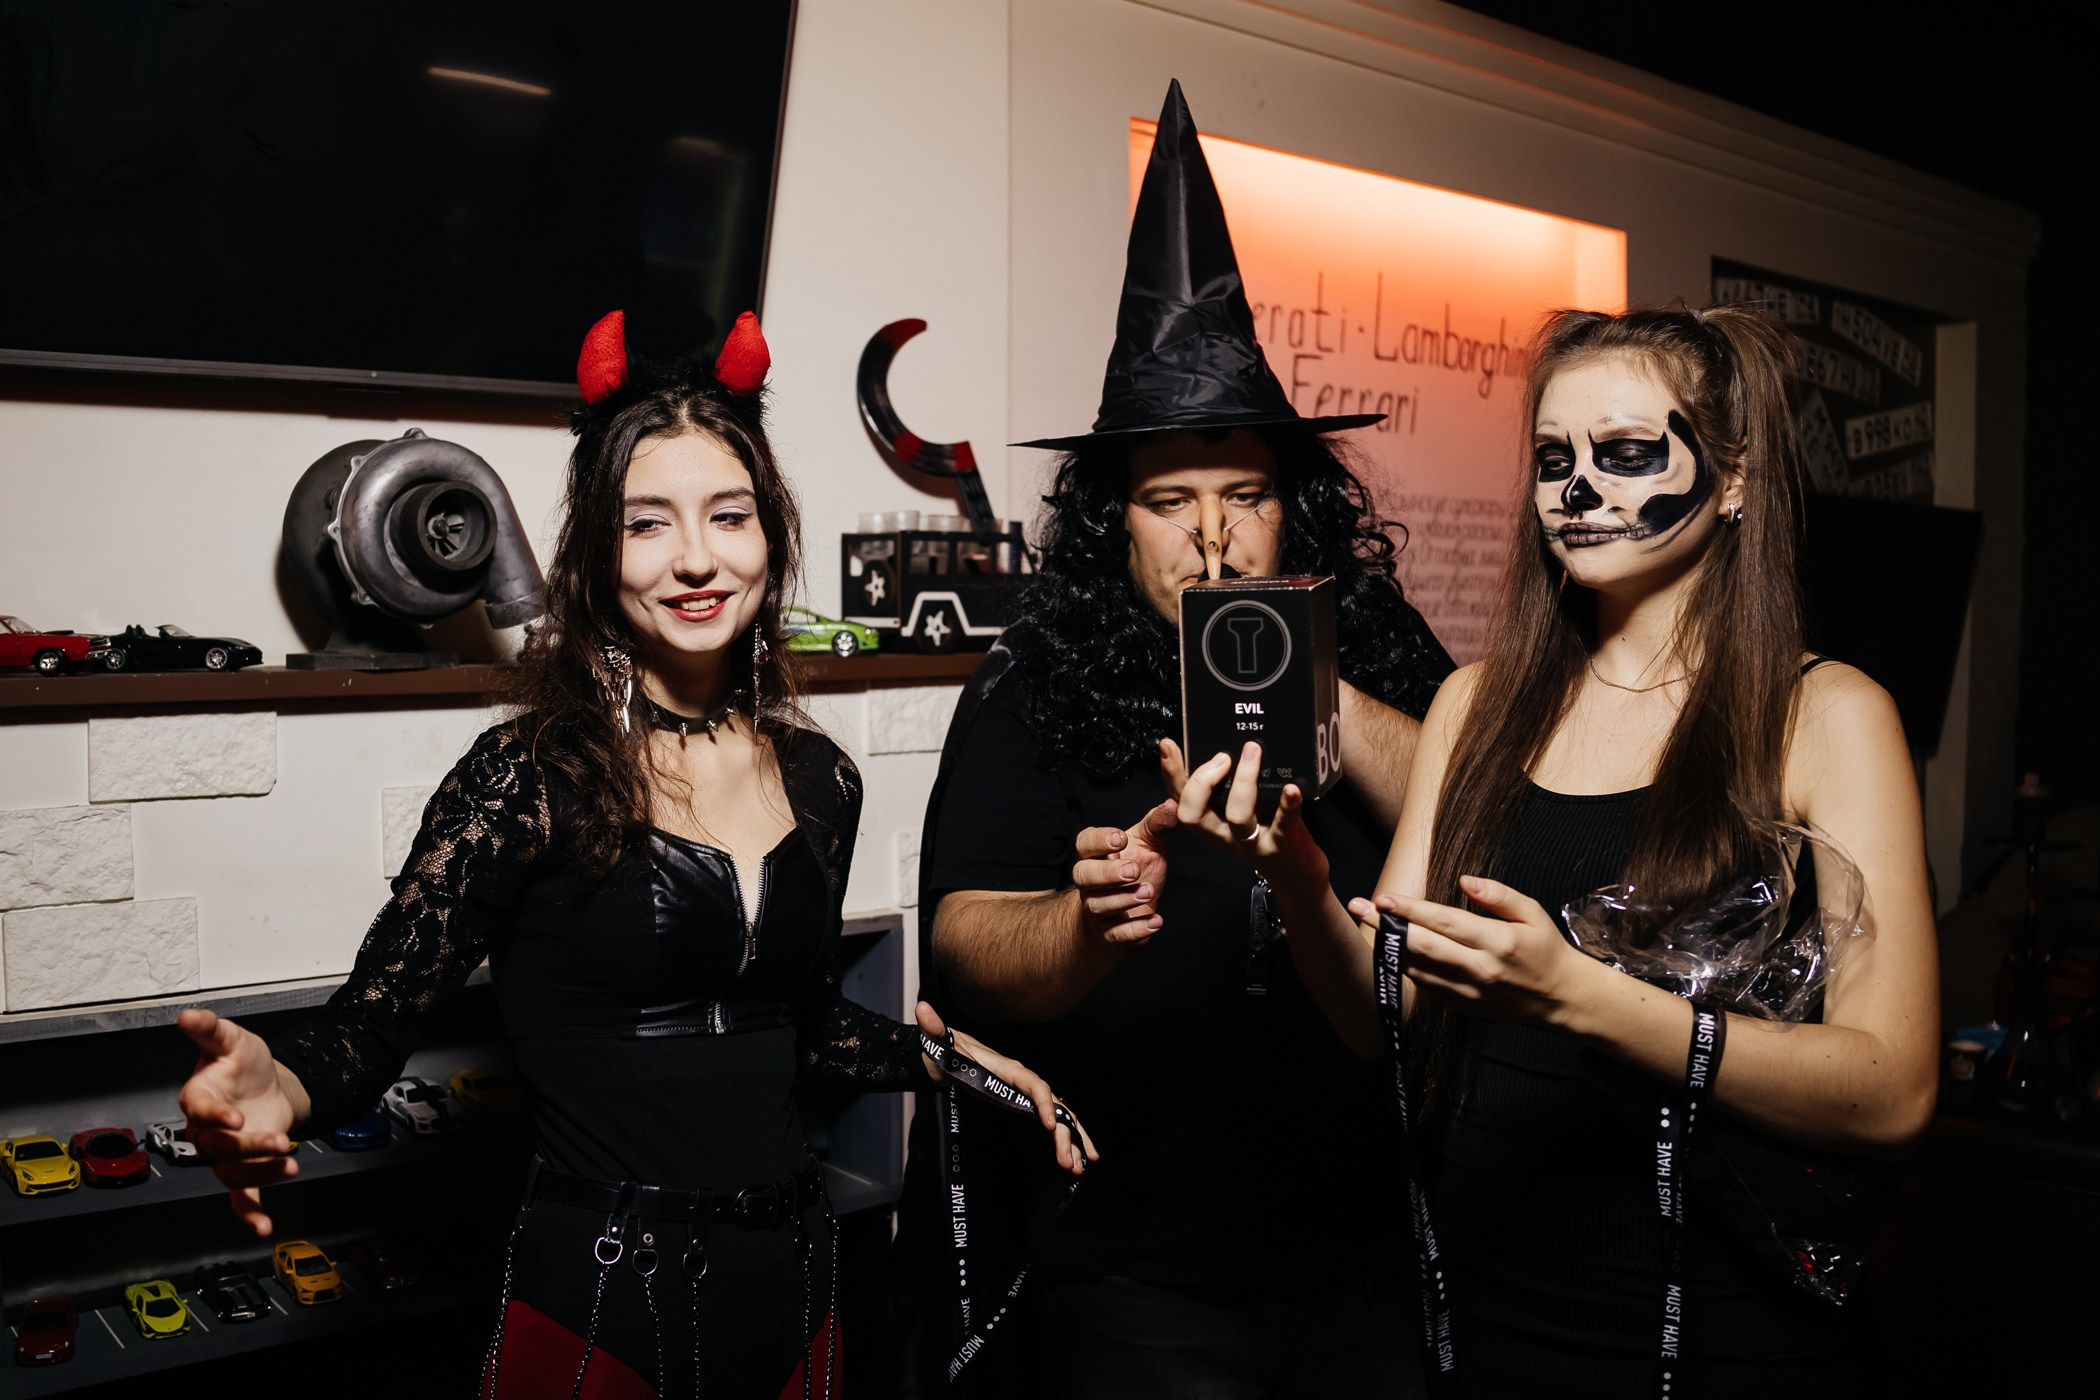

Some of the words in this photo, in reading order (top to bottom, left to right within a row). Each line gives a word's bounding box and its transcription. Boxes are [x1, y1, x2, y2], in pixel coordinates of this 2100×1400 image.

[1252, 271, 1347, 355] erati
[1292, 353, 1419, 435] Ferrari
[1235, 702, 1264, 714] EVIL
[1236, 722, 1259, 731] 12-15
[1384, 932, 1401, 973] MUST
[1696, 1012, 1715, 1052] MUST
[1689, 1053, 1710, 1089] HAVE
[984, 1075, 1015, 1100] MUST
[1015, 1095, 1034, 1110] HA
[951, 1103, 960, 1133] MUST
[1656, 1141, 1673, 1177] HAVE
[951, 1184, 965, 1213] HAVE
[1657, 1180, 1672, 1217] MUST
[953, 1216, 968, 1248] MUST
[1424, 1225, 1439, 1261] MUST
[1008, 1270, 1027, 1298] HAVE
[1664, 1284, 1682, 1322] MUST
[958, 1334, 985, 1364] MUST
[1438, 1340, 1454, 1373] MUST
[1661, 1321, 1680, 1359] HAVE
